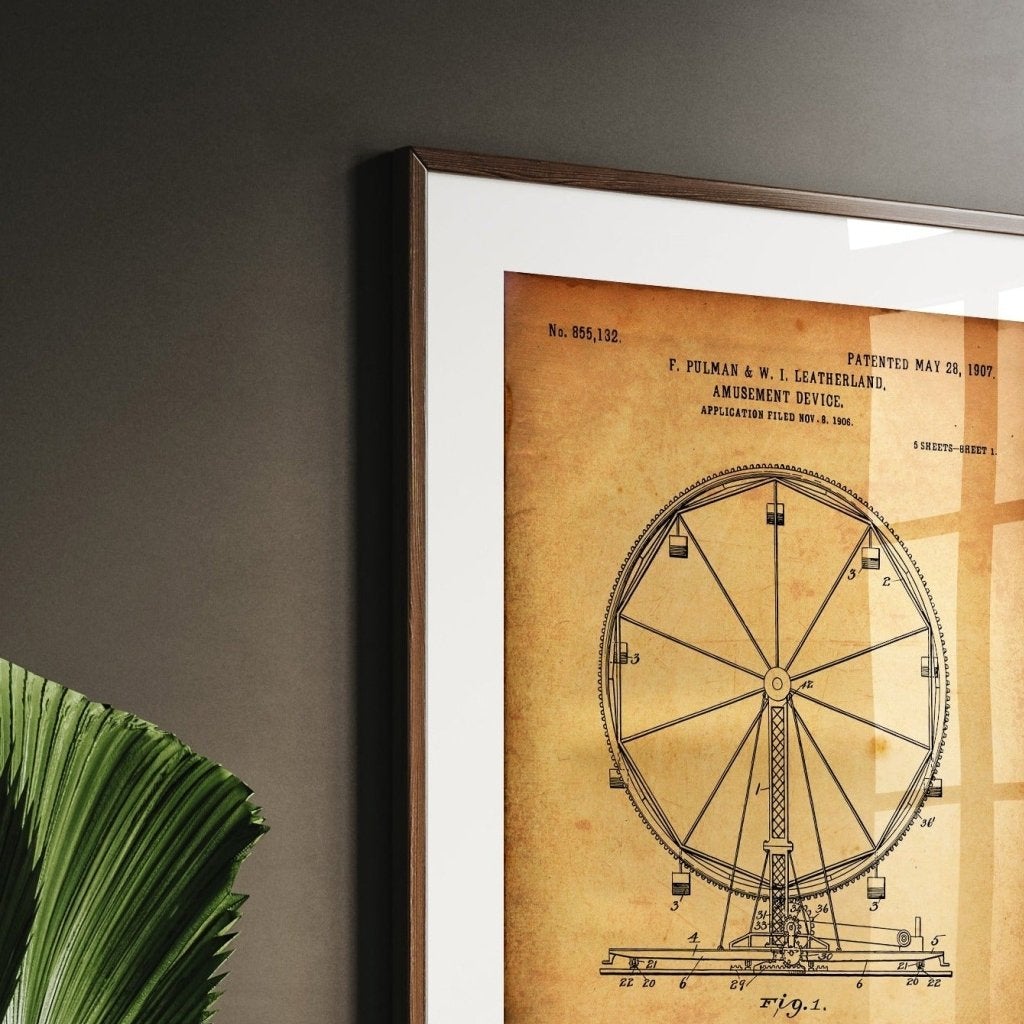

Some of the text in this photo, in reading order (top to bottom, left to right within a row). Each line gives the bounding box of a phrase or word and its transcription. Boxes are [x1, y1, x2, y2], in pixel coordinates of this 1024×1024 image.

[548, 323, 622, 343] No. 855,132.
[669, 358, 680, 372] F.
[687, 360, 738, 376] PULMAN
[744, 365, 753, 379] &
[759, 366, 774, 380] W.
[780, 368, 788, 382] I.
[847, 352, 996, 379] PATENTED MAY 28, 1907.
[713, 384, 844, 409] AMUSEMENT DEVICE.
[701, 405, 764, 420] APPLICATION
[767, 411, 795, 423] FILED
[832, 416, 854, 427] 1906.
[913, 440, 919, 450] 5
[847, 568, 857, 581] 3
[882, 576, 892, 587] 2
[630, 653, 640, 665] 3
[671, 901, 680, 911] 3
[815, 903, 829, 914] 36
[869, 901, 879, 911] 3
[756, 910, 767, 920] 31
[754, 921, 767, 930] 33
[688, 931, 701, 944] 4
[645, 960, 658, 969] 21
[897, 962, 909, 970] 21
[619, 978, 656, 988] 22 20
[679, 980, 687, 990] 6
[729, 979, 746, 991] 29
[856, 978, 864, 989] 6
[906, 977, 941, 988] 20 22
